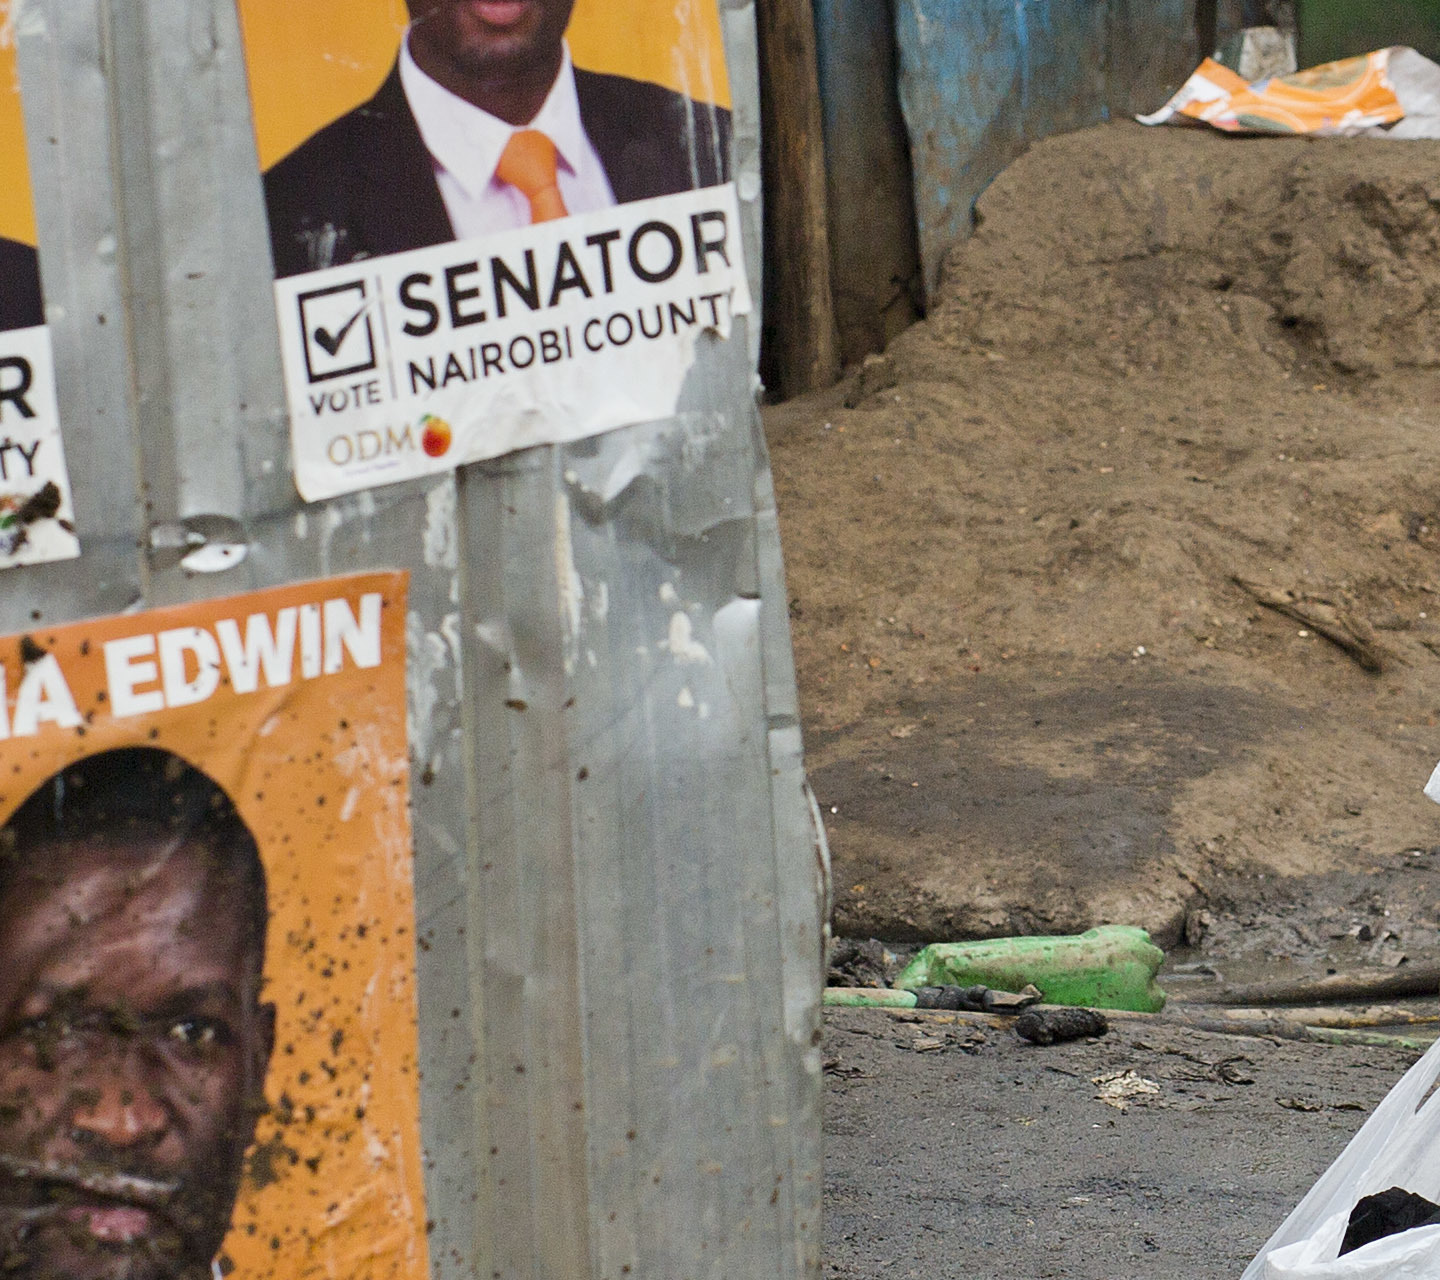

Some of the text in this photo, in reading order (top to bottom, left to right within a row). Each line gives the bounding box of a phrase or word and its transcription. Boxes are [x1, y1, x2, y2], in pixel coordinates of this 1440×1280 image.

[400, 211, 732, 338] SENATOR
[308, 380, 382, 417] VOTE
[407, 327, 574, 395] NAIROBI
[326, 423, 417, 468] ODM
[103, 592, 383, 719] EDWIN
